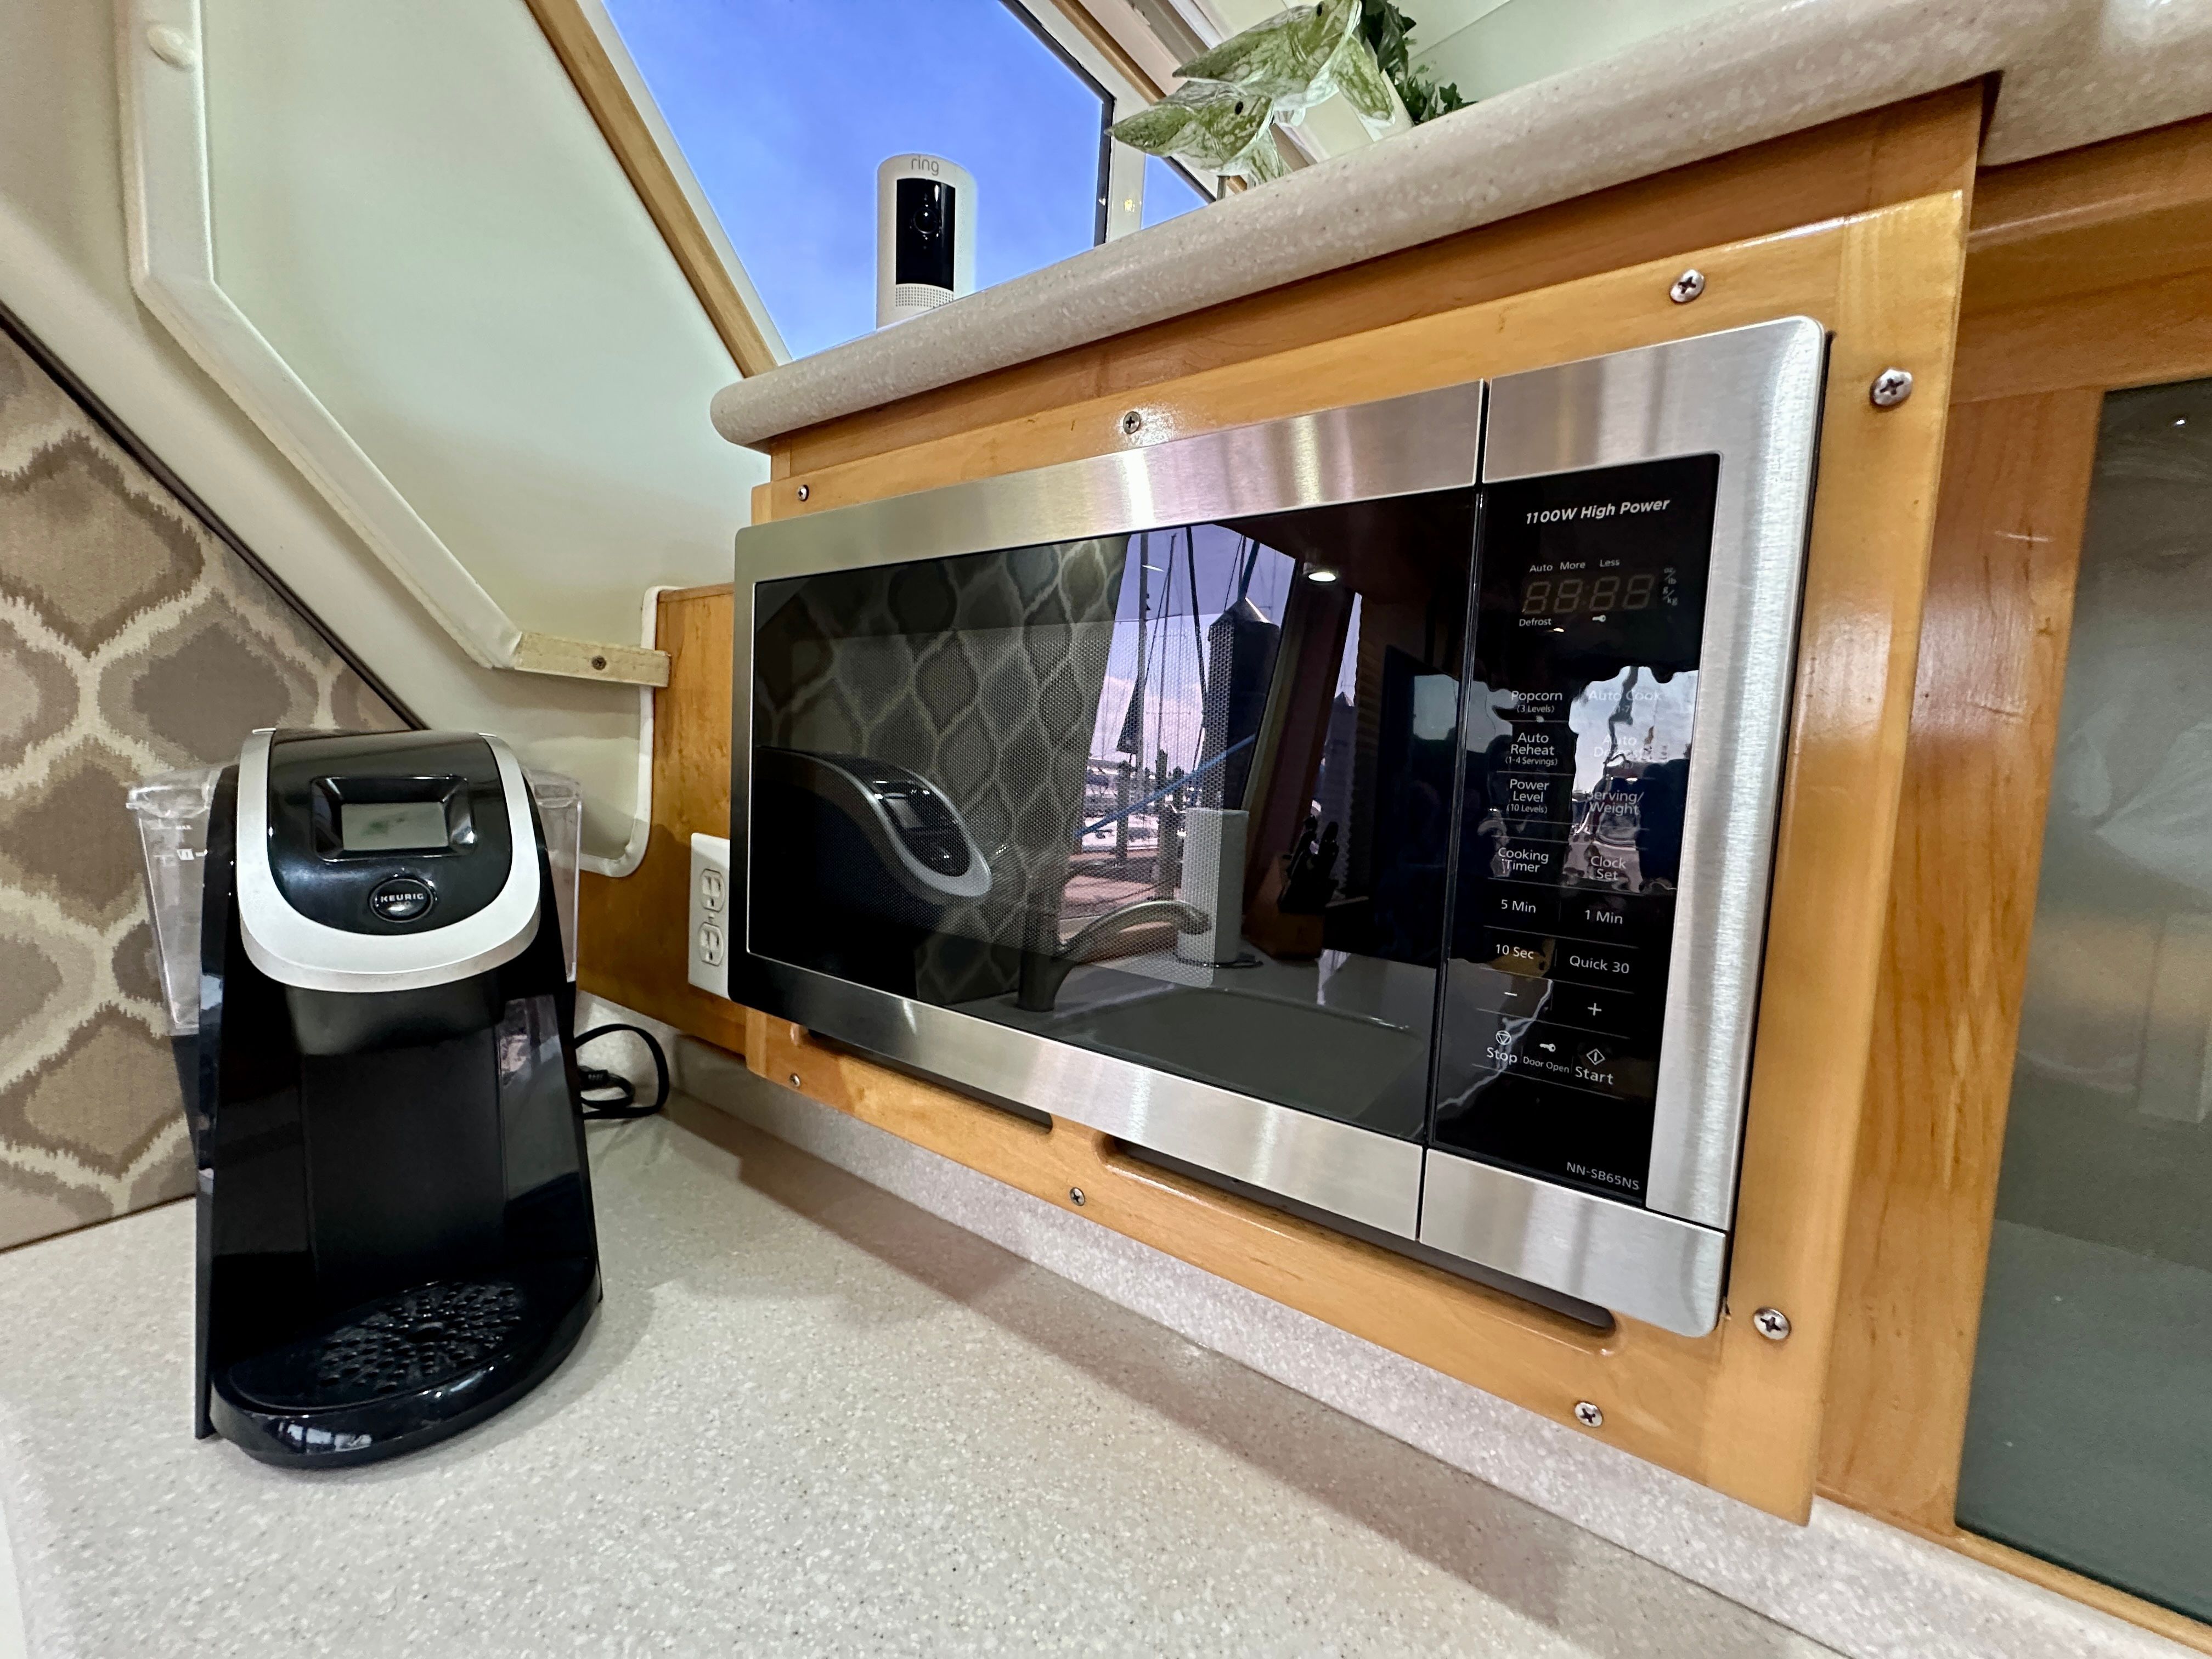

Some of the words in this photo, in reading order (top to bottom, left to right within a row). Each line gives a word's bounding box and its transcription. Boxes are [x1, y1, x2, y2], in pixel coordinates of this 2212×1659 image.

[911, 155, 939, 176] ring
[1526, 508, 1577, 524] 1100W
[1581, 503, 1615, 519] High
[1620, 499, 1671, 514] Power
[1530, 564, 1553, 572] Auto
[1560, 562, 1585, 570] More
[1519, 618, 1551, 627] Defrost
[1511, 691, 1562, 702] Popcorn
[1589, 690, 1622, 701] Auto
[1528, 704, 1555, 713] Levels)
[1517, 733, 1549, 743] Auto
[1511, 744, 1555, 755] Reheat
[1522, 758, 1558, 767] Servings)
[1510, 779, 1549, 791] Power
[1513, 792, 1544, 803] Level
[1521, 804, 1548, 813] Levels)
[1590, 802, 1639, 817] Weight
[1498, 848, 1549, 864] Cooking
[1504, 859, 1540, 873] Timer
[1591, 856, 1627, 870] Clock
[1596, 868, 1619, 881] Set
[381, 893, 424, 902] KEURIG
[1501, 900, 1508, 910] 5
[1513, 901, 1536, 913] Min
[1585, 910, 1590, 920] 1
[1596, 911, 1623, 925] Min
[1496, 944, 1510, 955] 10
[1513, 946, 1534, 960] Sec
[1570, 955, 1609, 971] Quick
[1612, 962, 1630, 974] 30
[1487, 1047, 1518, 1064] Stop
[1523, 1057, 1545, 1067] Door
[1546, 1062, 1570, 1074] Open
[1575, 1066, 1614, 1086] Start
[1566, 1161, 1640, 1190] NN-SB65NS
